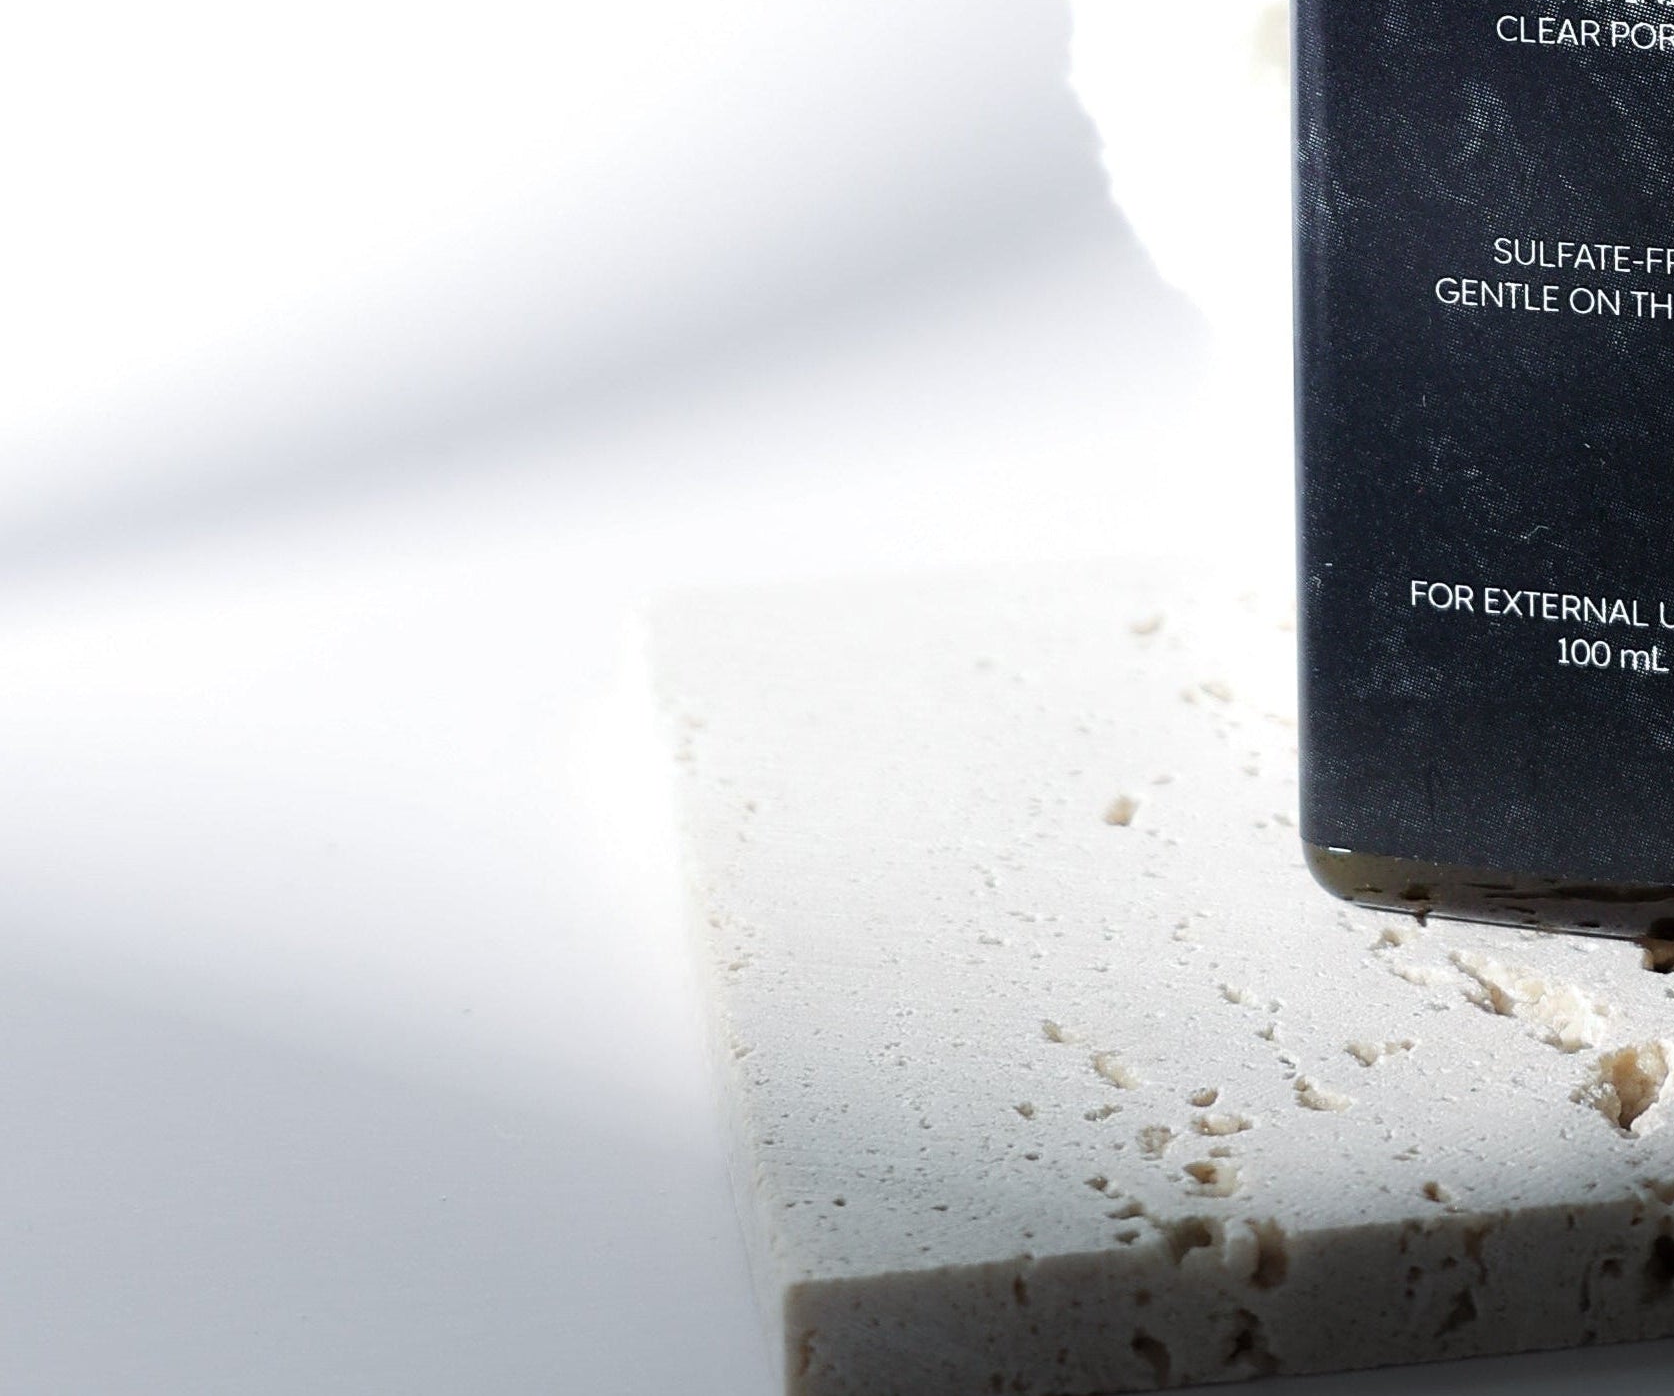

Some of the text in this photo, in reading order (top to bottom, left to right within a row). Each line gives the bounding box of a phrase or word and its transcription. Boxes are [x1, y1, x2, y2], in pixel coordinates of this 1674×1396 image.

[1496, 15, 1601, 47] CLEAR
[1435, 277, 1560, 313] GENTLE
[1569, 287, 1621, 316] ON
[1410, 580, 1474, 613] FOR
[1483, 586, 1649, 629] EXTERNAL
[1557, 638, 1669, 672] 100 mL
